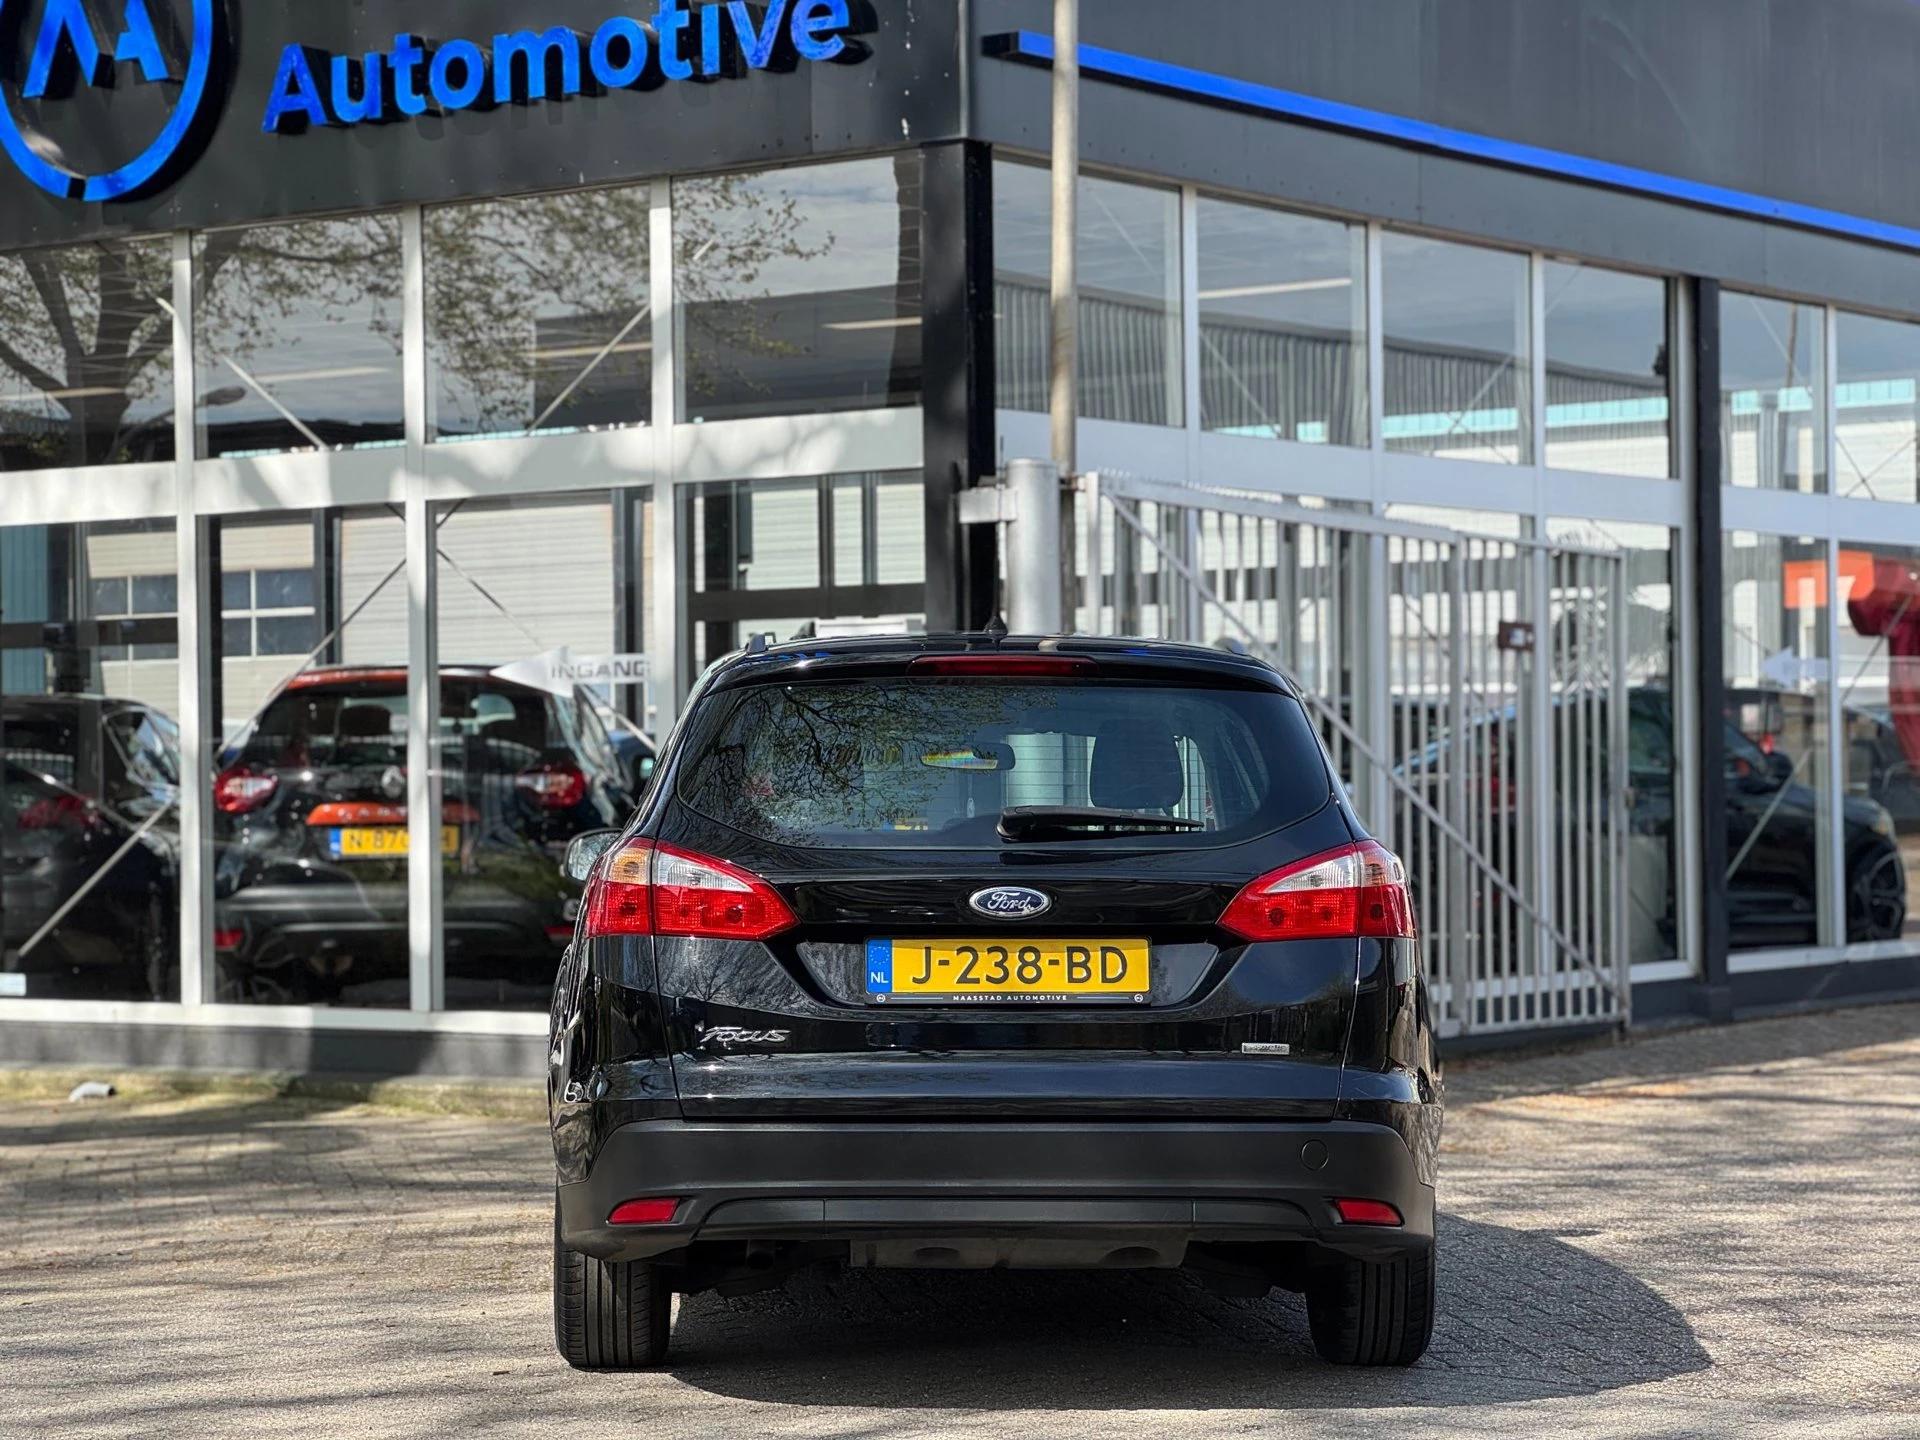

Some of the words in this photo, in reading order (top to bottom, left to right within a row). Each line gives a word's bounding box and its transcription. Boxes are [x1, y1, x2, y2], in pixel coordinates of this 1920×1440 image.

[262, 0, 850, 132] Automotive
[987, 891, 1035, 911] Ford
[870, 971, 889, 984] NL
[912, 945, 1128, 985] J-238-BD
